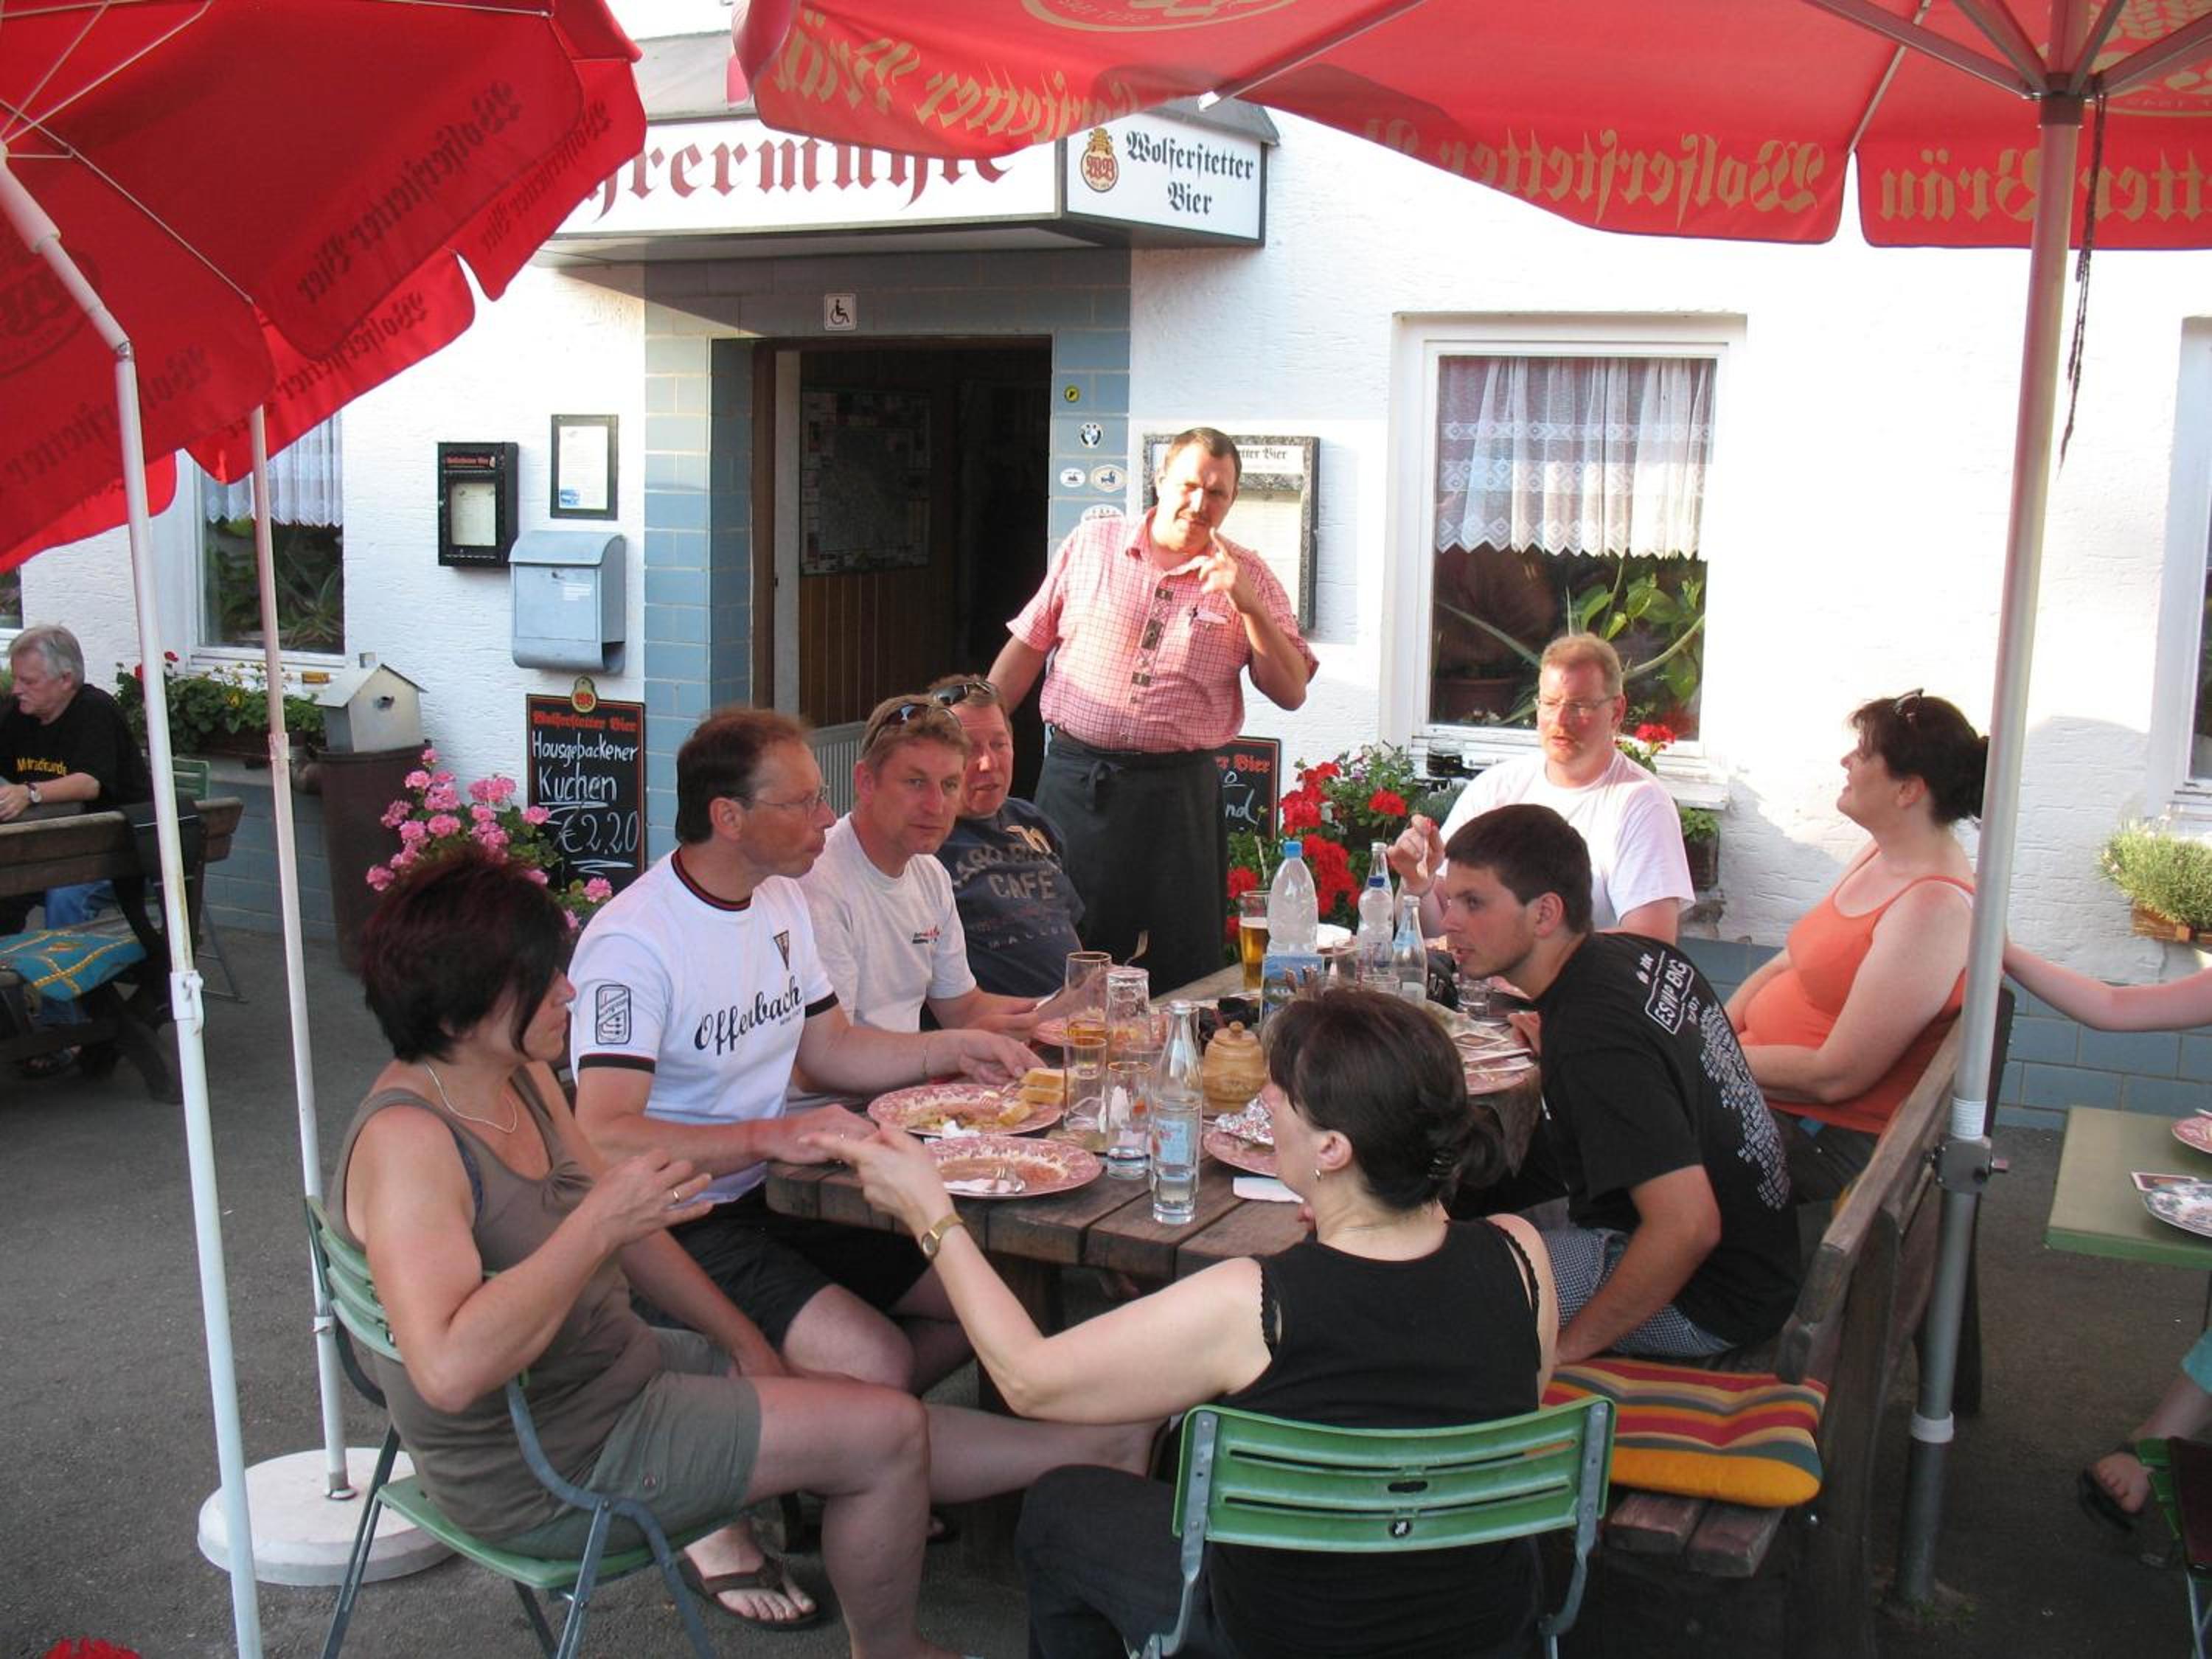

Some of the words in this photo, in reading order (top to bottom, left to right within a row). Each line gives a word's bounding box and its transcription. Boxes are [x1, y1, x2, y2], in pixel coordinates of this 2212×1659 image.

[1167, 181, 1213, 215] Bier
[539, 762, 617, 801] Kuchen
[694, 975, 804, 1056] Offenbach
